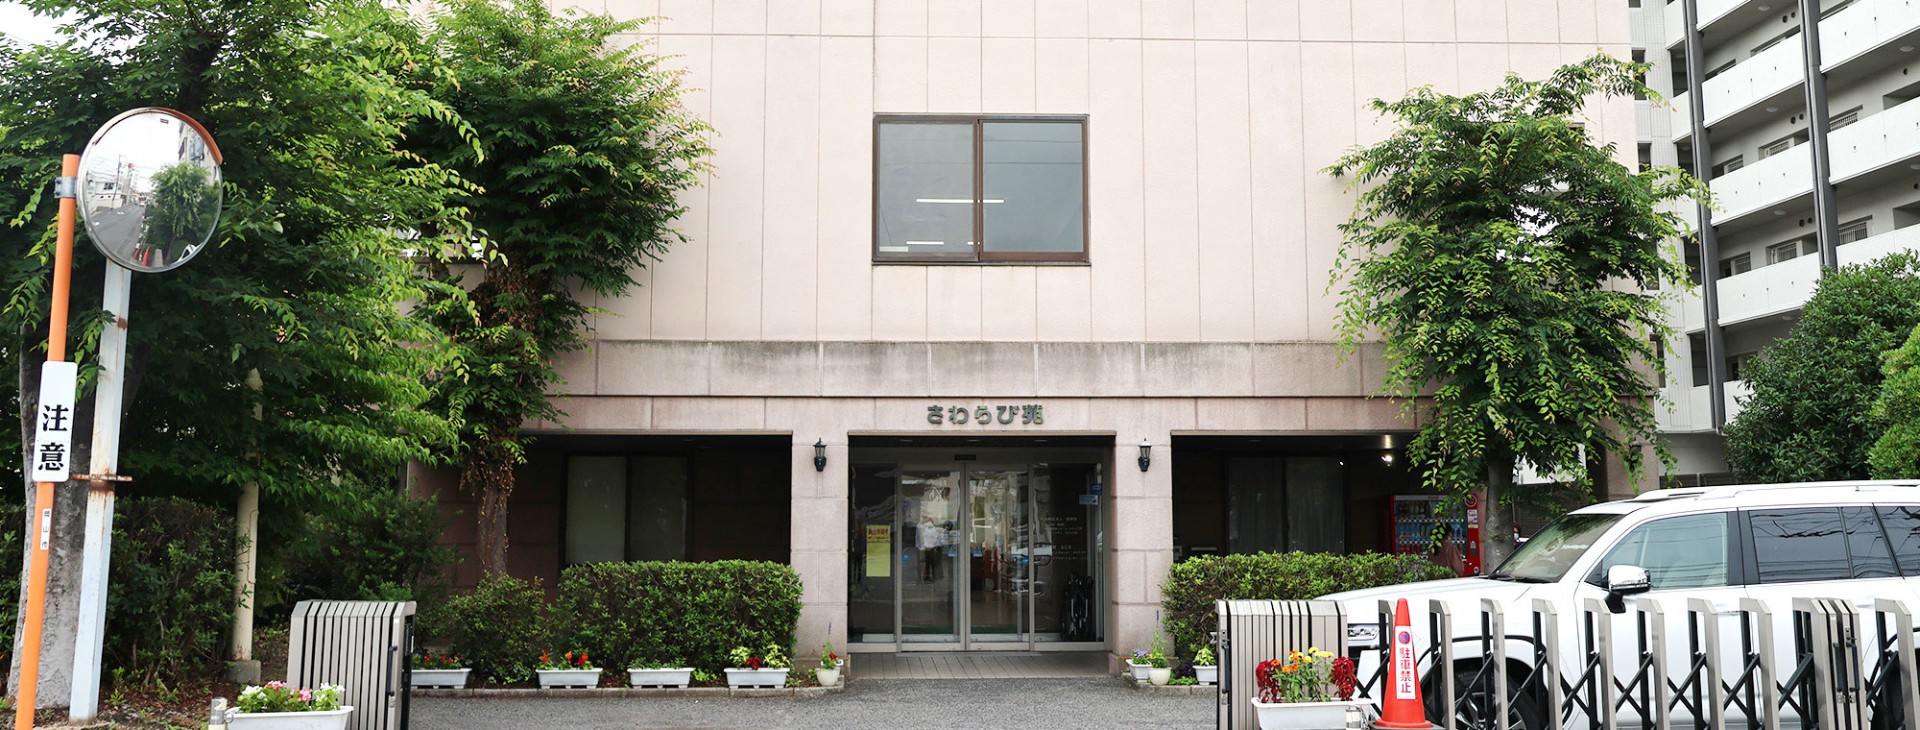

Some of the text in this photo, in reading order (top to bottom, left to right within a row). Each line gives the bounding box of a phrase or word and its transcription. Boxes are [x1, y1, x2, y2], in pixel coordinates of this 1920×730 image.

[38, 404, 69, 471] 注意
[927, 405, 1044, 425] さわらび苑
[1399, 647, 1412, 693] 駐車禁止
